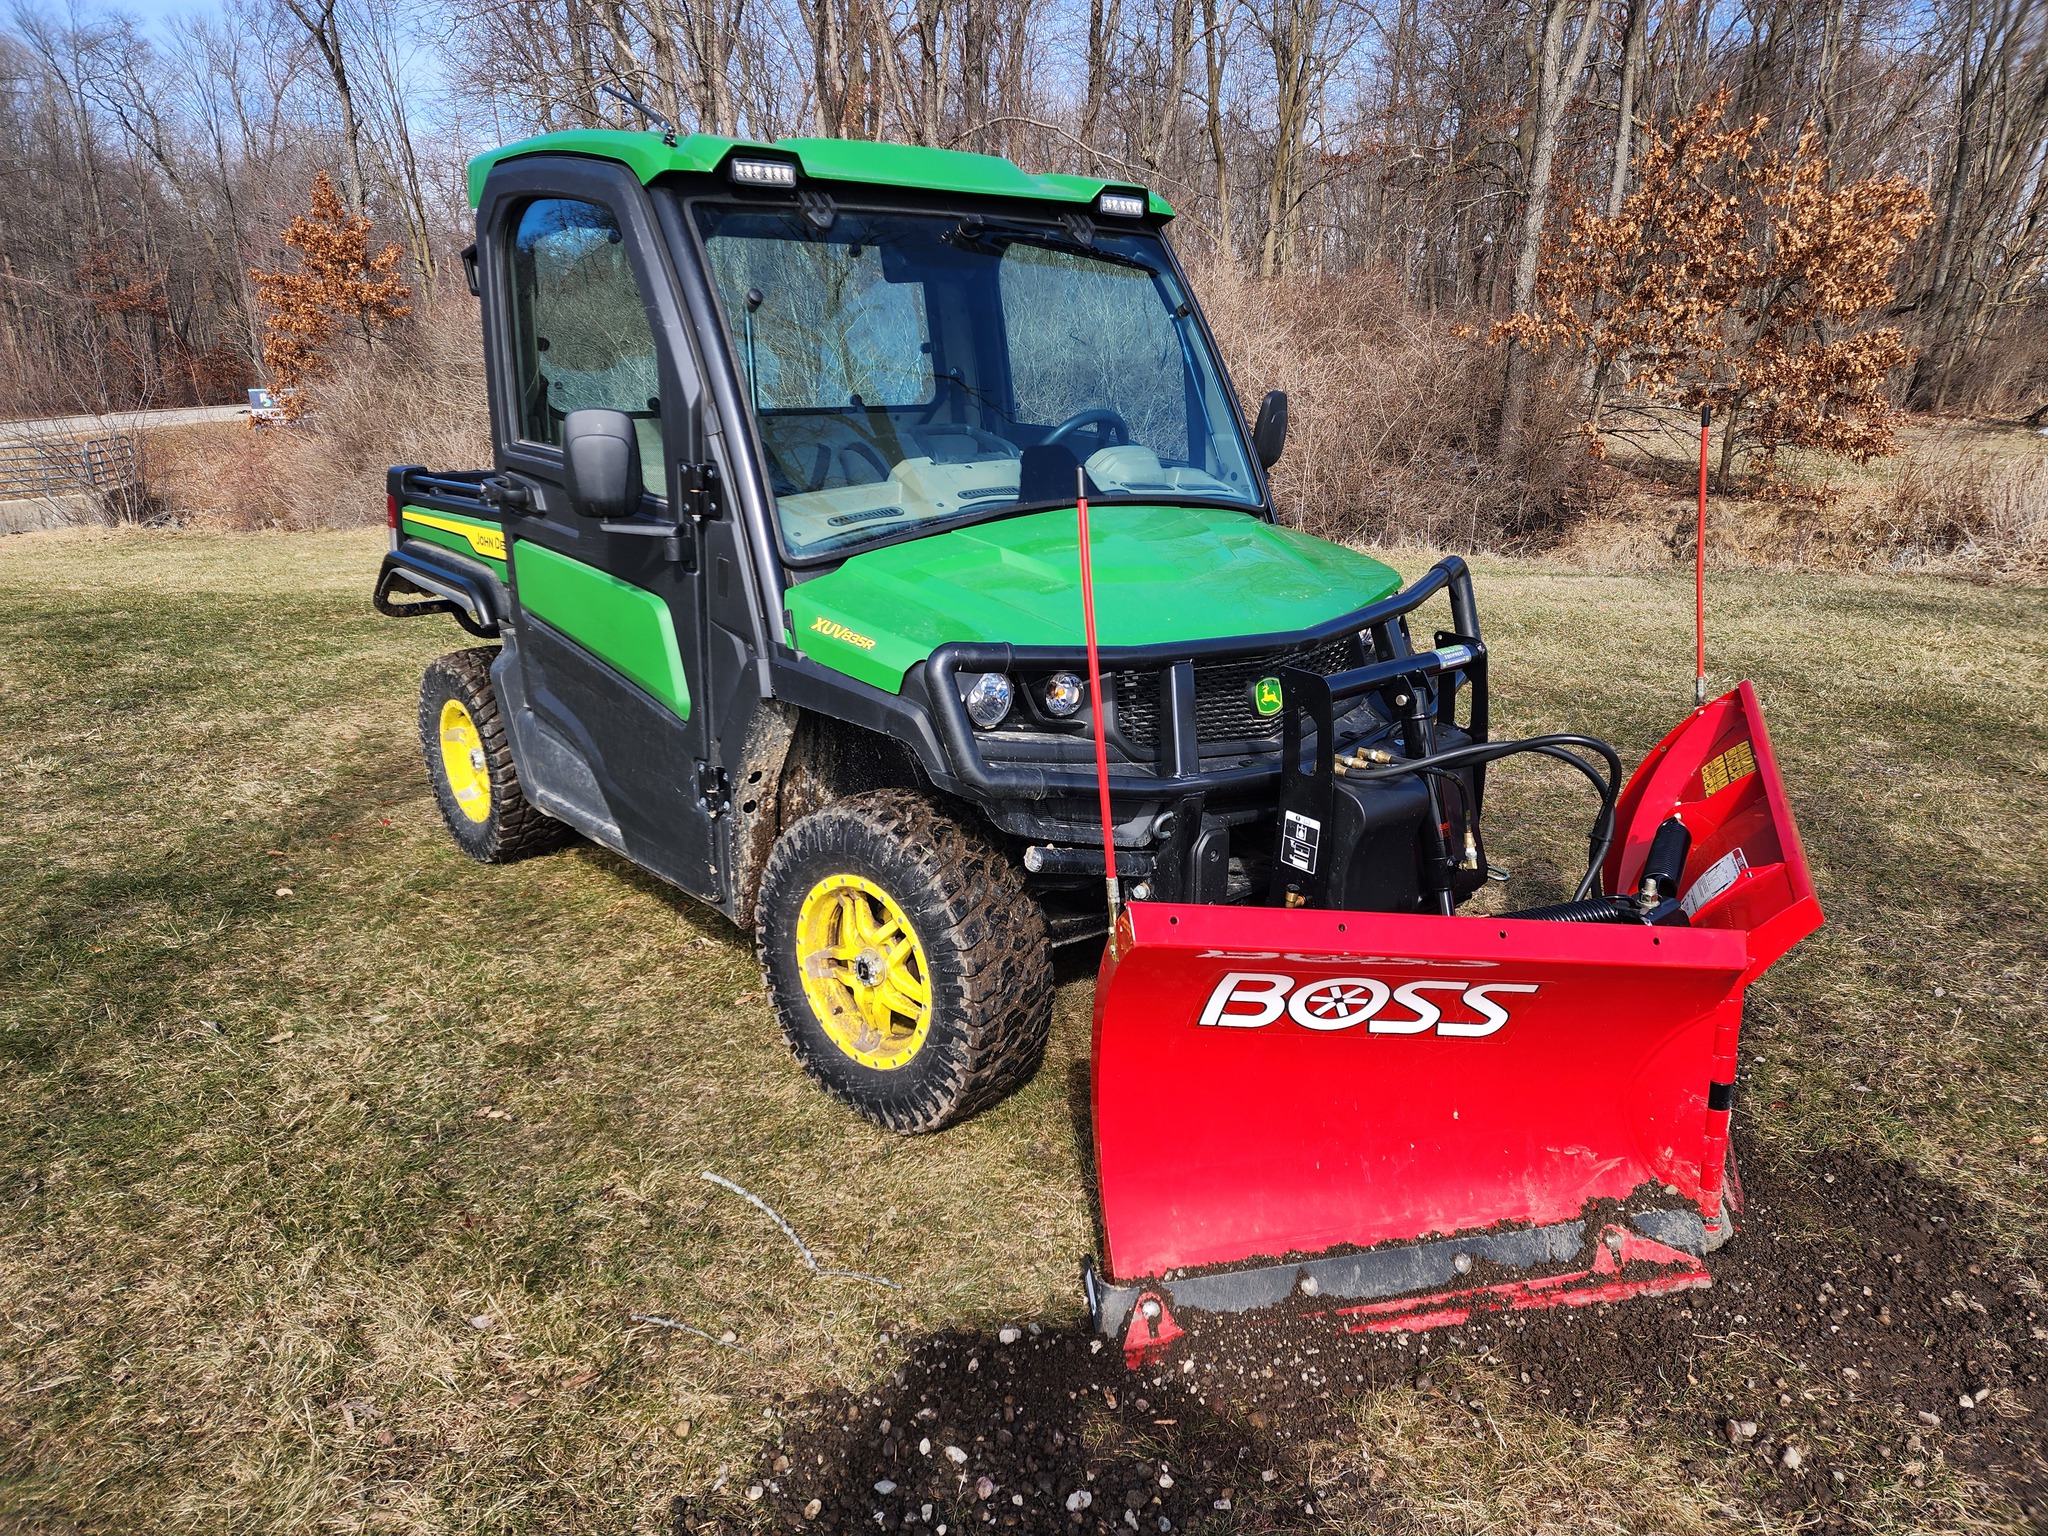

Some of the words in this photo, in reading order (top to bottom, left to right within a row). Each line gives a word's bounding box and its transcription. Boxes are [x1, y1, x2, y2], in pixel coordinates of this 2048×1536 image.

[476, 533, 494, 548] JOHN
[808, 615, 877, 651] XUV835R
[1197, 971, 1541, 1038] BOSS
